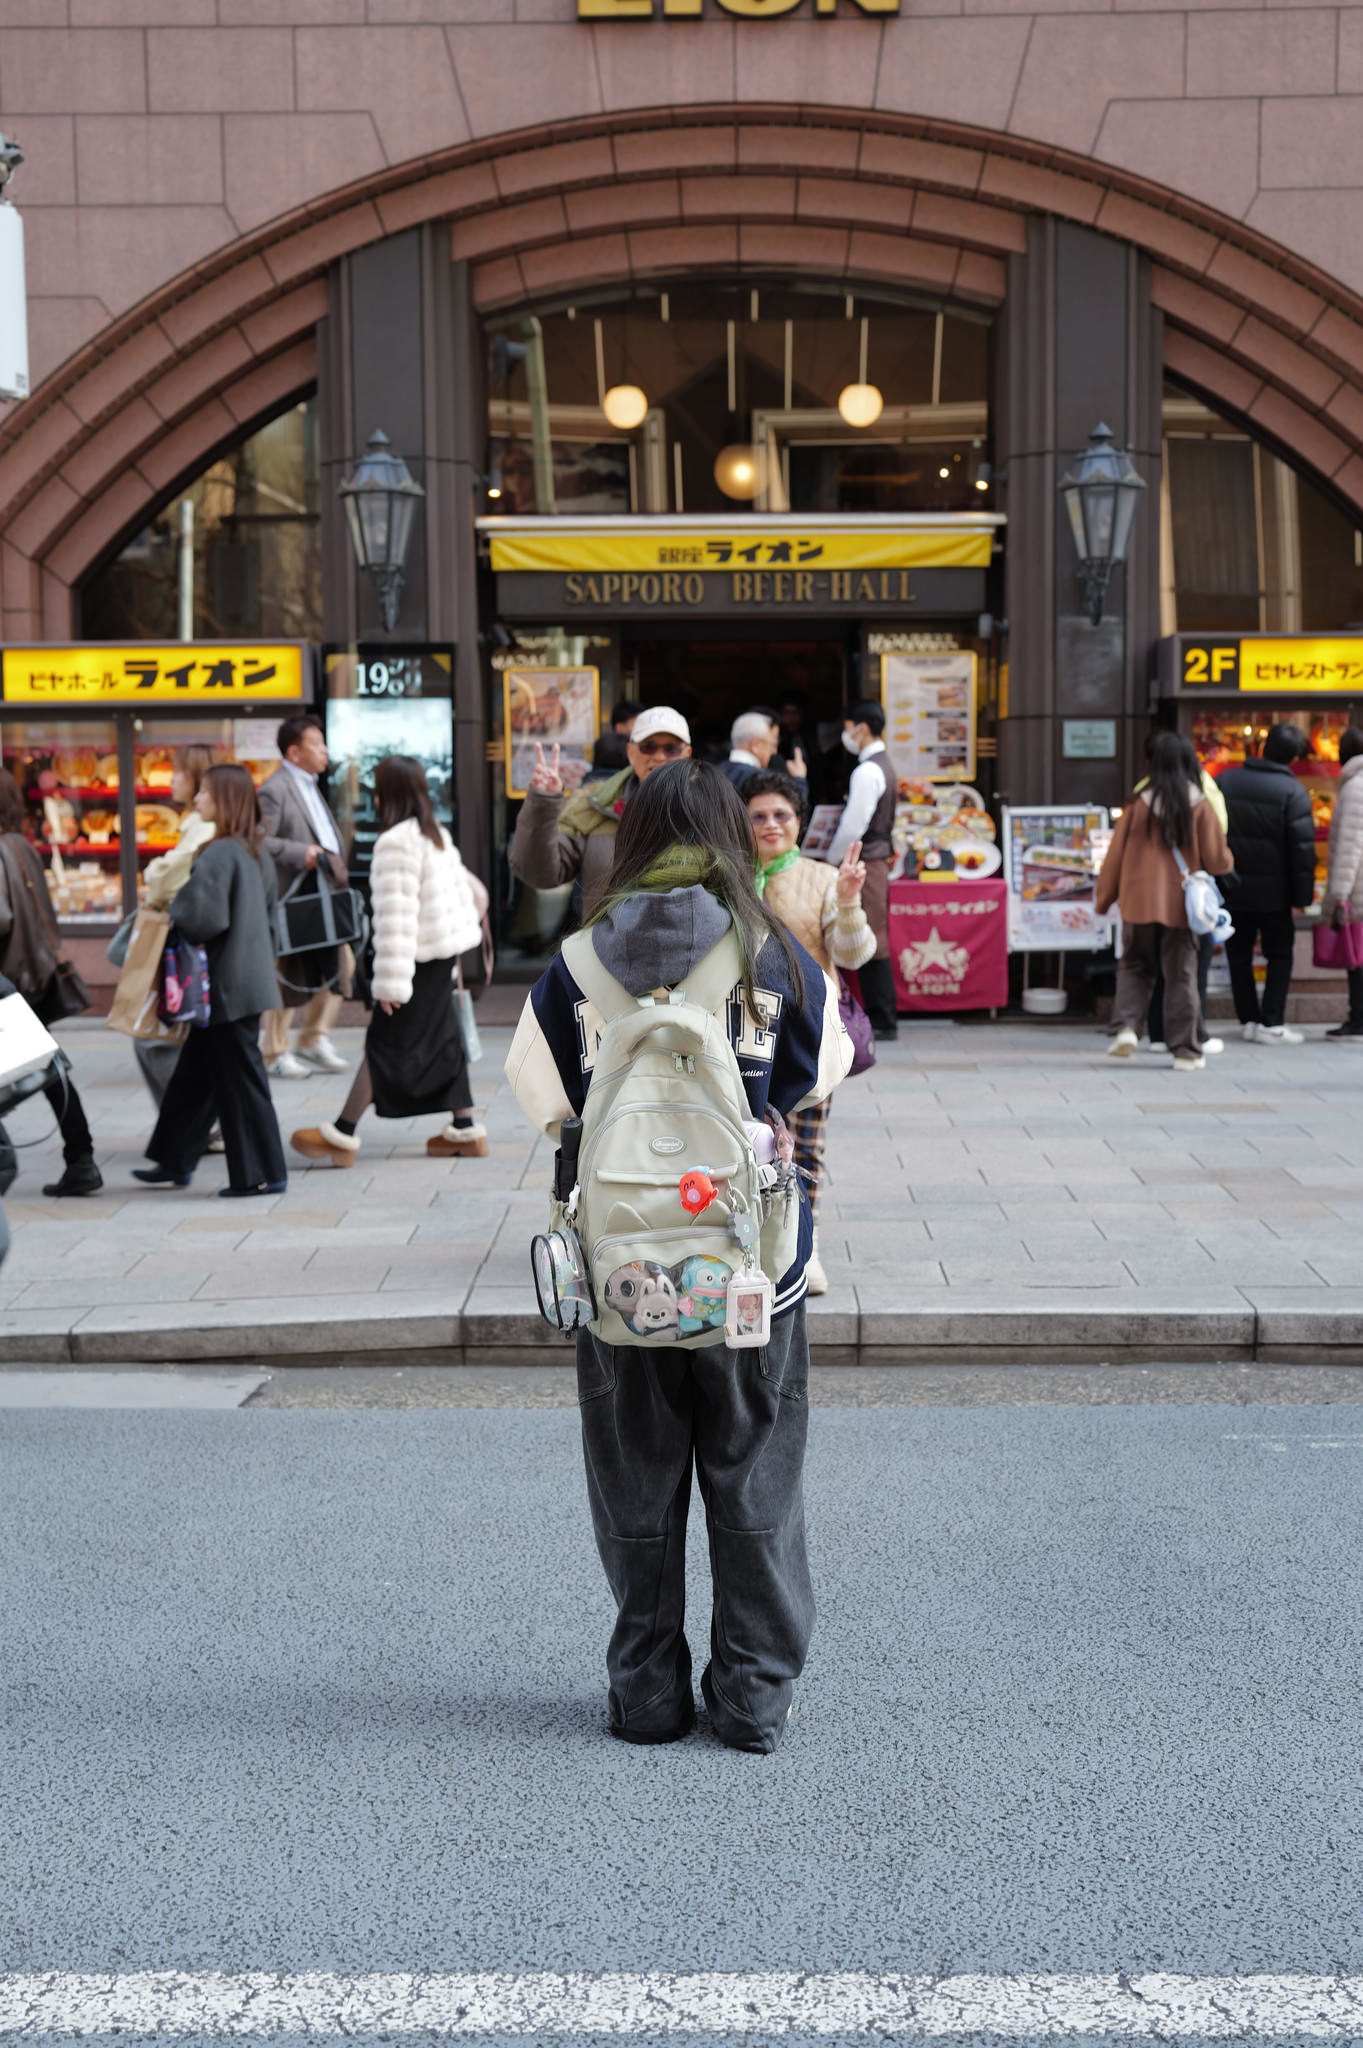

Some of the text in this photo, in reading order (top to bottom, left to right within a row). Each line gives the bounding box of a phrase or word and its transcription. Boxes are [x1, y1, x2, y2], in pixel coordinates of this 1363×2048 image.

[564, 570, 916, 602] SAPPORO BEER-HALL
[1184, 647, 1237, 682] 2F
